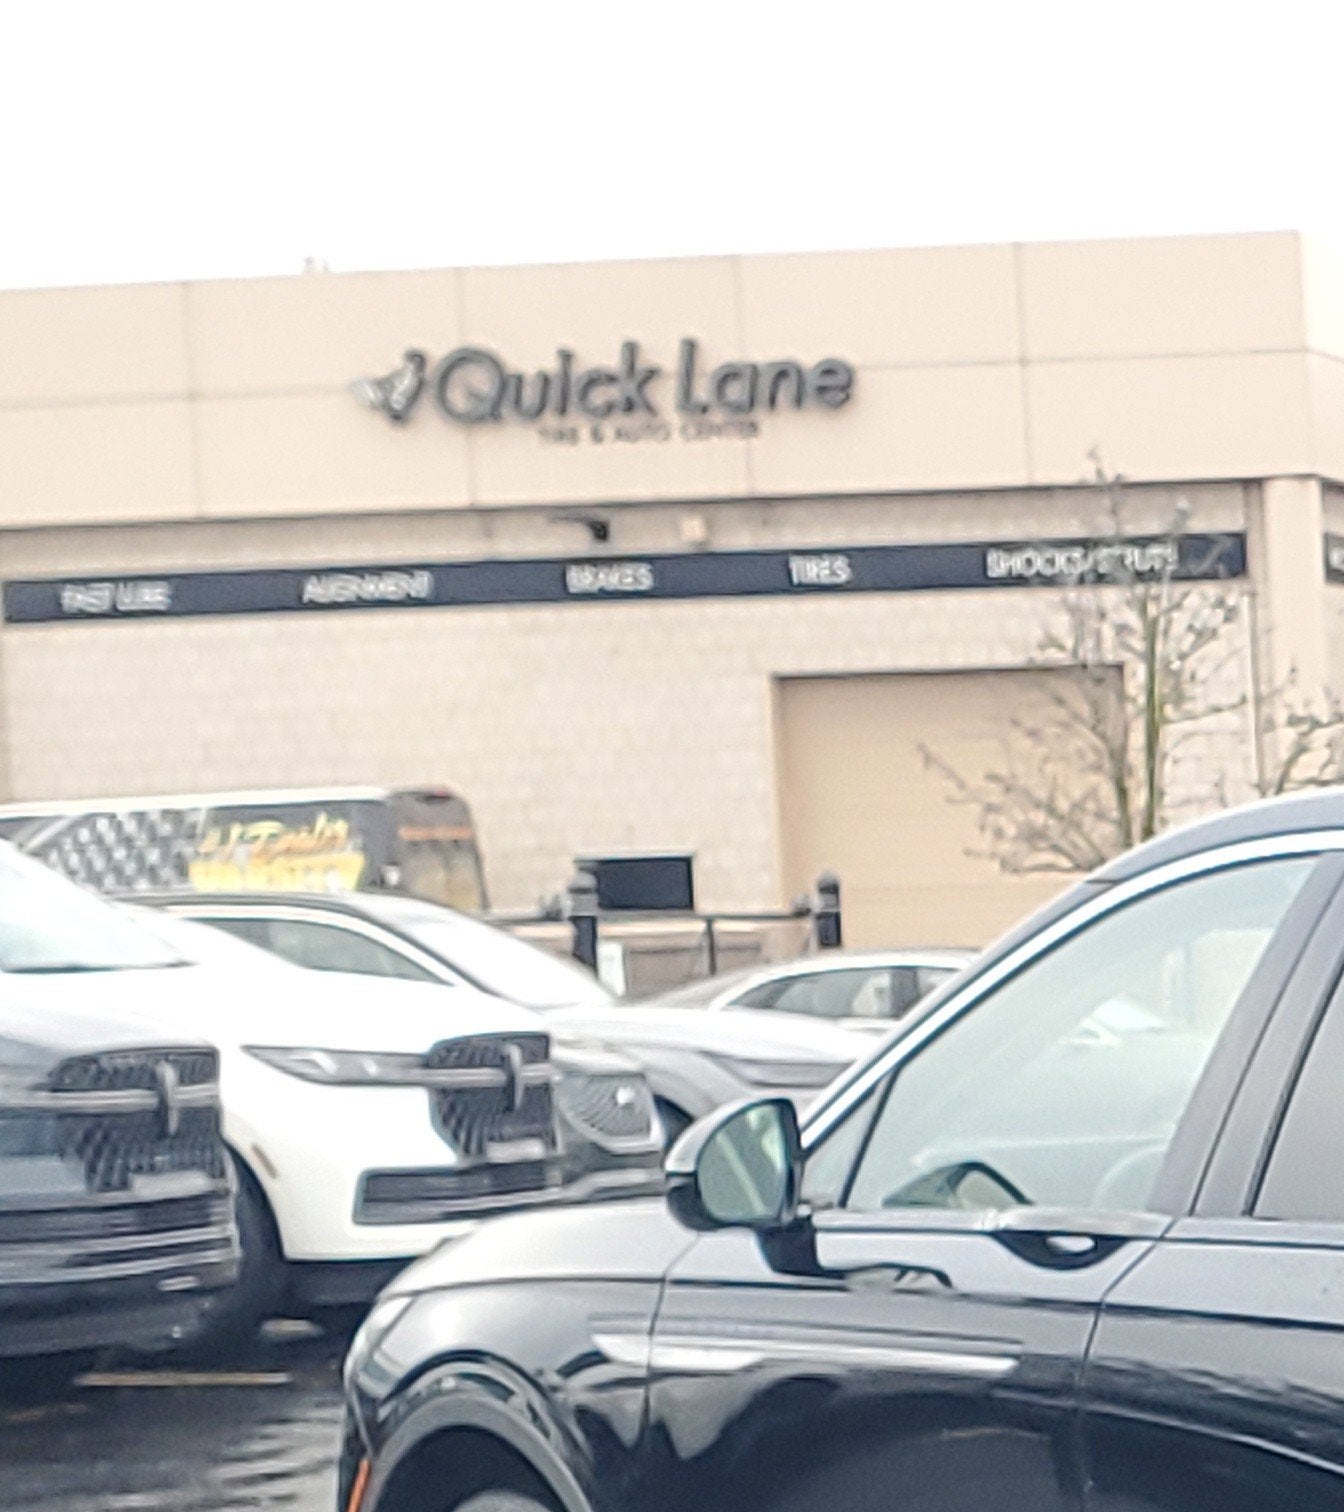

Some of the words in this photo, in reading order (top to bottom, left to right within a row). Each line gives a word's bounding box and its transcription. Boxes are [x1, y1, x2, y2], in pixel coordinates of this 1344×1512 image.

[437, 341, 659, 425] Quick
[680, 338, 856, 413] Lane
[788, 553, 851, 586] TIRES
